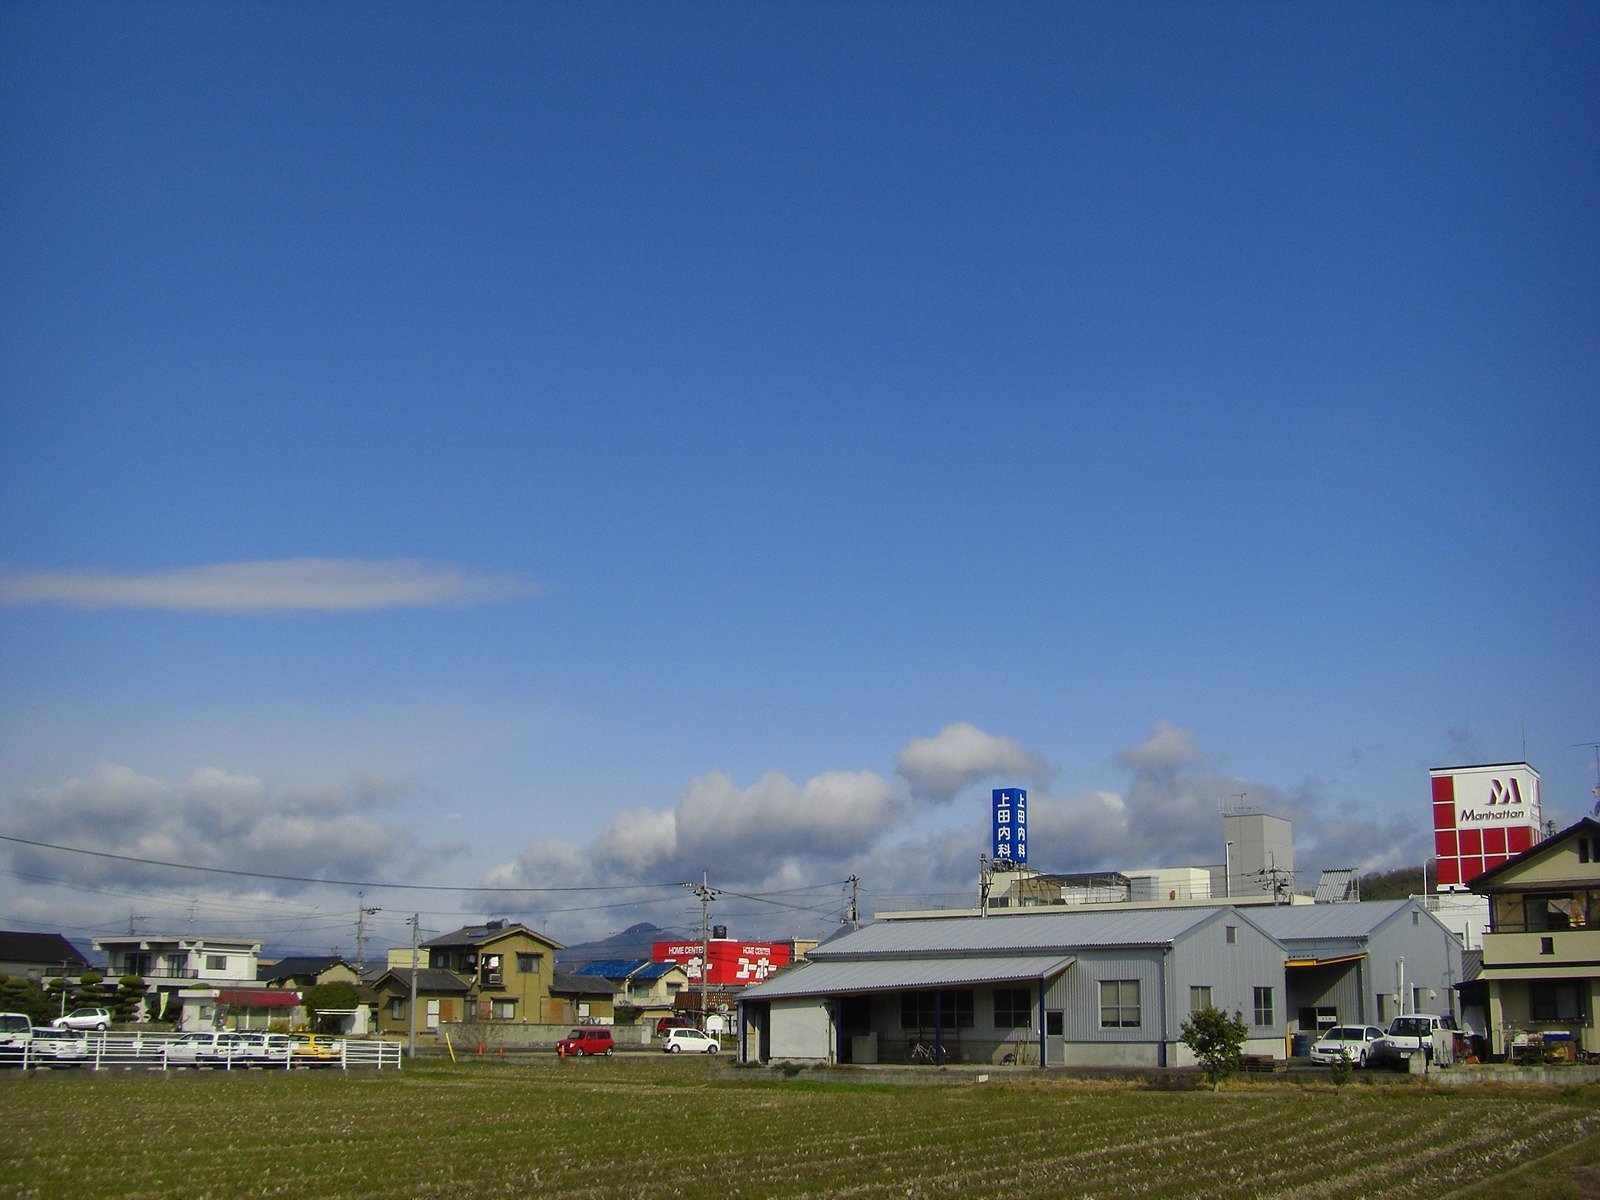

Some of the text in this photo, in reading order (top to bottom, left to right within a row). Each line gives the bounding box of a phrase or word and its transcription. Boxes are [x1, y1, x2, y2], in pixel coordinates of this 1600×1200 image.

[1460, 809, 1525, 822] Manhattan
[997, 792, 1011, 858] 上田内科
[1017, 793, 1026, 858] 上田内科
[668, 946, 704, 955] HOME CENTE
[742, 946, 771, 956] HOME CENTER
